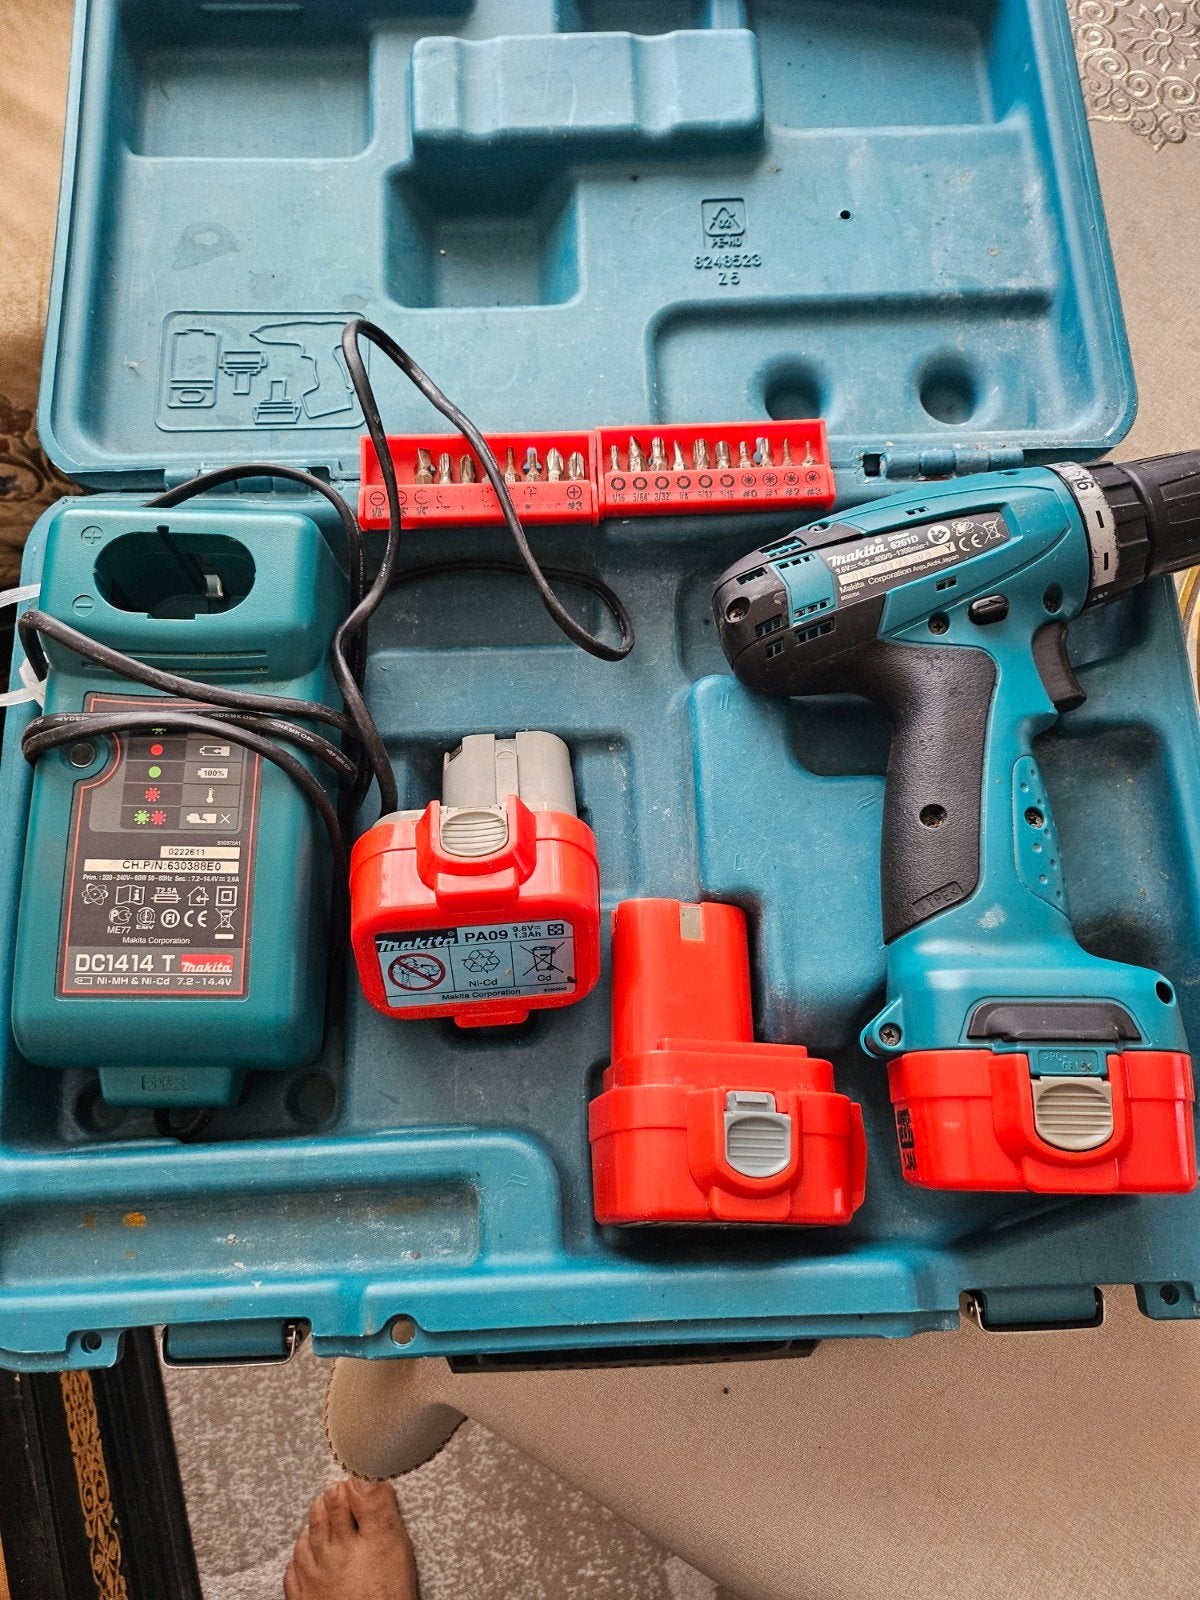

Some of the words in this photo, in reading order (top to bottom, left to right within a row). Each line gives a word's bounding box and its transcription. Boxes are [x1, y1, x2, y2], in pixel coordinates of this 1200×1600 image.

[1073, 475, 1095, 491] 16
[890, 535, 919, 550] 6261D
[839, 581, 866, 594] Makita
[867, 568, 912, 585] Corporation
[203, 769, 225, 777] 100%
[168, 848, 206, 856] 0222611
[122, 860, 222, 872] CH.P/N:630388E0
[464, 929, 509, 943] PA09
[513, 931, 542, 939] 1.3Ah
[122, 936, 147, 945] Makita
[148, 937, 191, 946] Corporation
[75, 953, 155, 973] DC1414
[161, 954, 176, 973] T
[96, 977, 129, 986] Ni-MH
[130, 978, 140, 986] &
[141, 977, 170, 986] Ni-Cd
[468, 978, 498, 988] Ni-Cd
[537, 974, 552, 982] Cd
[441, 992, 471, 1001] Makita
[473, 988, 521, 1000] Corporation
